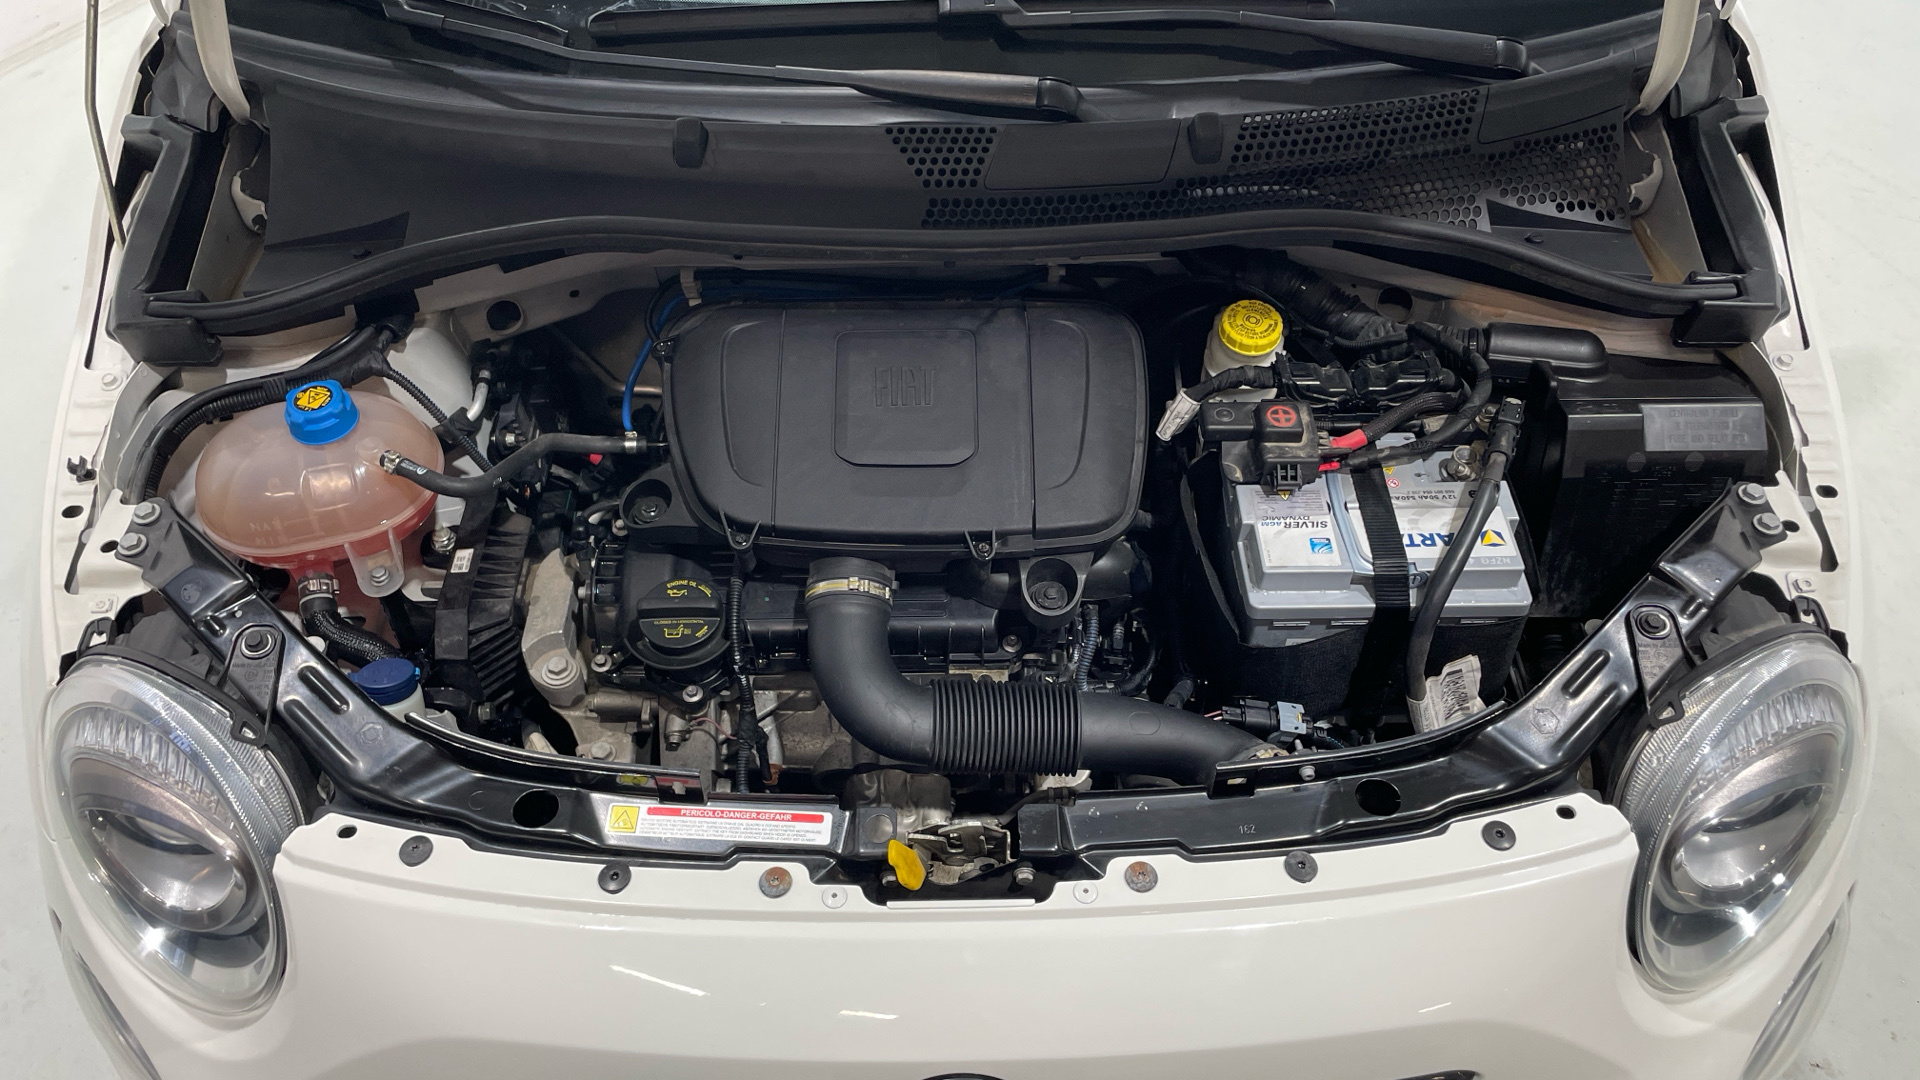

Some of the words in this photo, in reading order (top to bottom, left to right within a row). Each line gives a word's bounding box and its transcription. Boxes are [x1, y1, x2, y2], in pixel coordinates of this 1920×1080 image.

[874, 365, 937, 408] FIAT
[1283, 520, 1328, 529] SILVER
[1403, 532, 1455, 548] ART
[667, 580, 688, 588] ENGINE
[680, 809, 793, 822] PERICOLO-DANGER-GEFAHR
